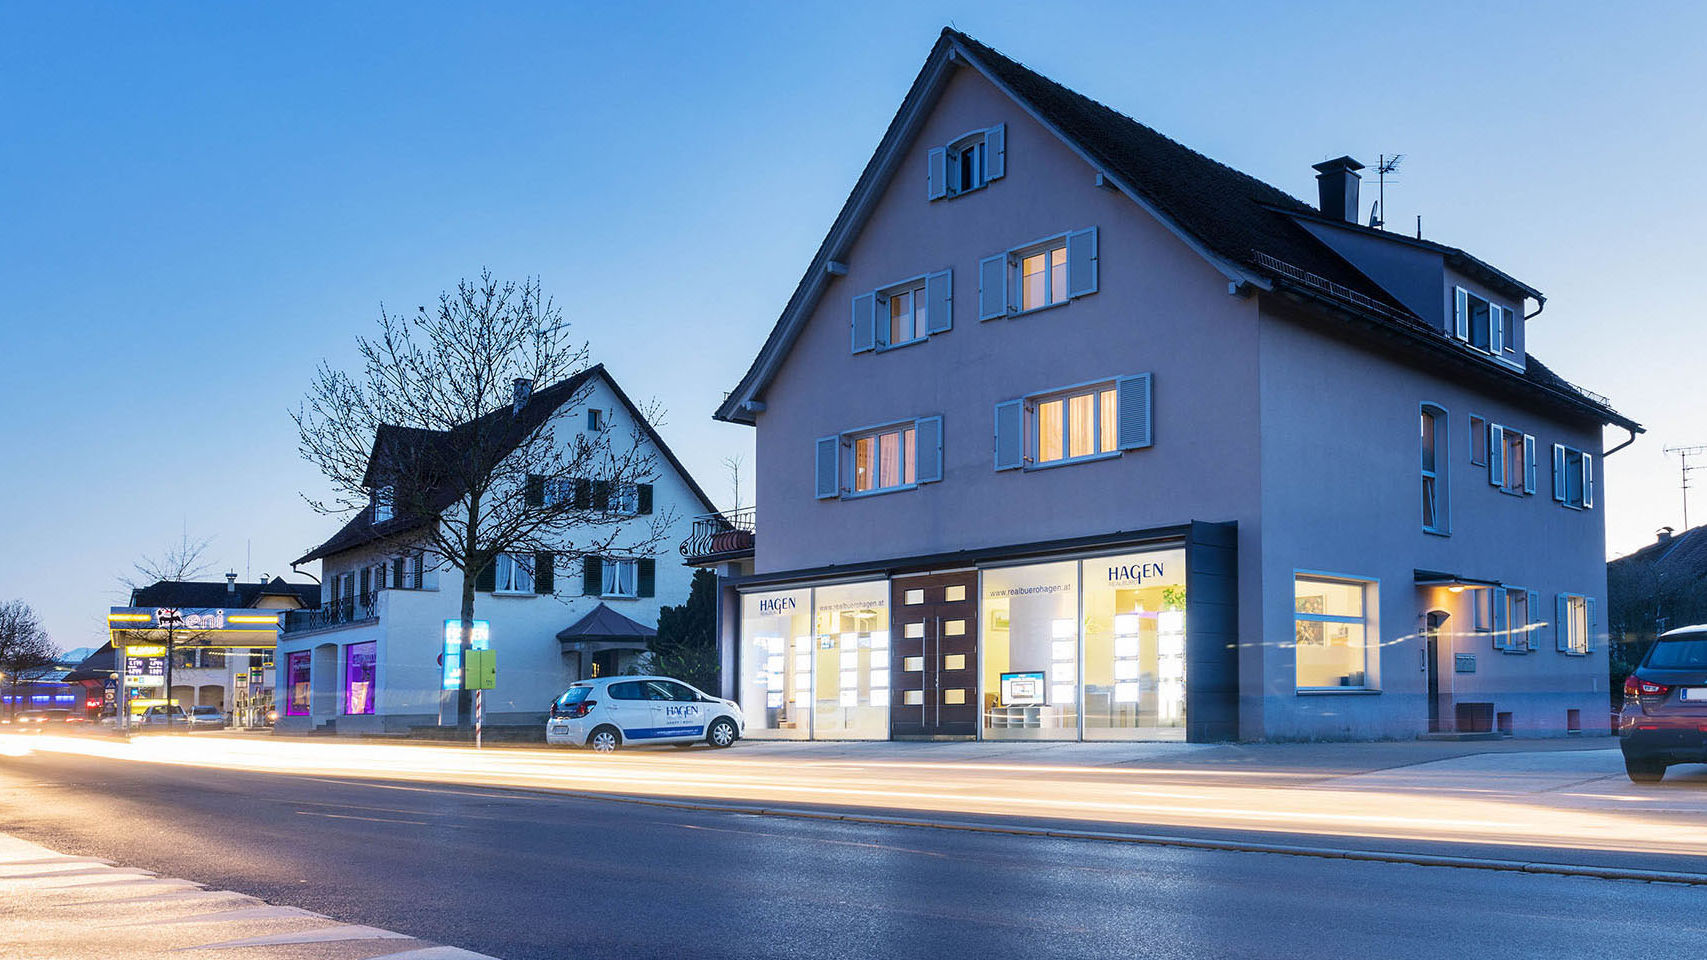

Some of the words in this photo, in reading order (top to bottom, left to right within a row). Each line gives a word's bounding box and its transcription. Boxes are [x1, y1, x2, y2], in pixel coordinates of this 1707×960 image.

[1108, 562, 1164, 585] HAGEN
[989, 584, 1071, 597] www.realbuerohagen.at
[760, 597, 796, 615] HAGEN
[185, 608, 224, 629] eni
[666, 705, 699, 718] HAGEN
